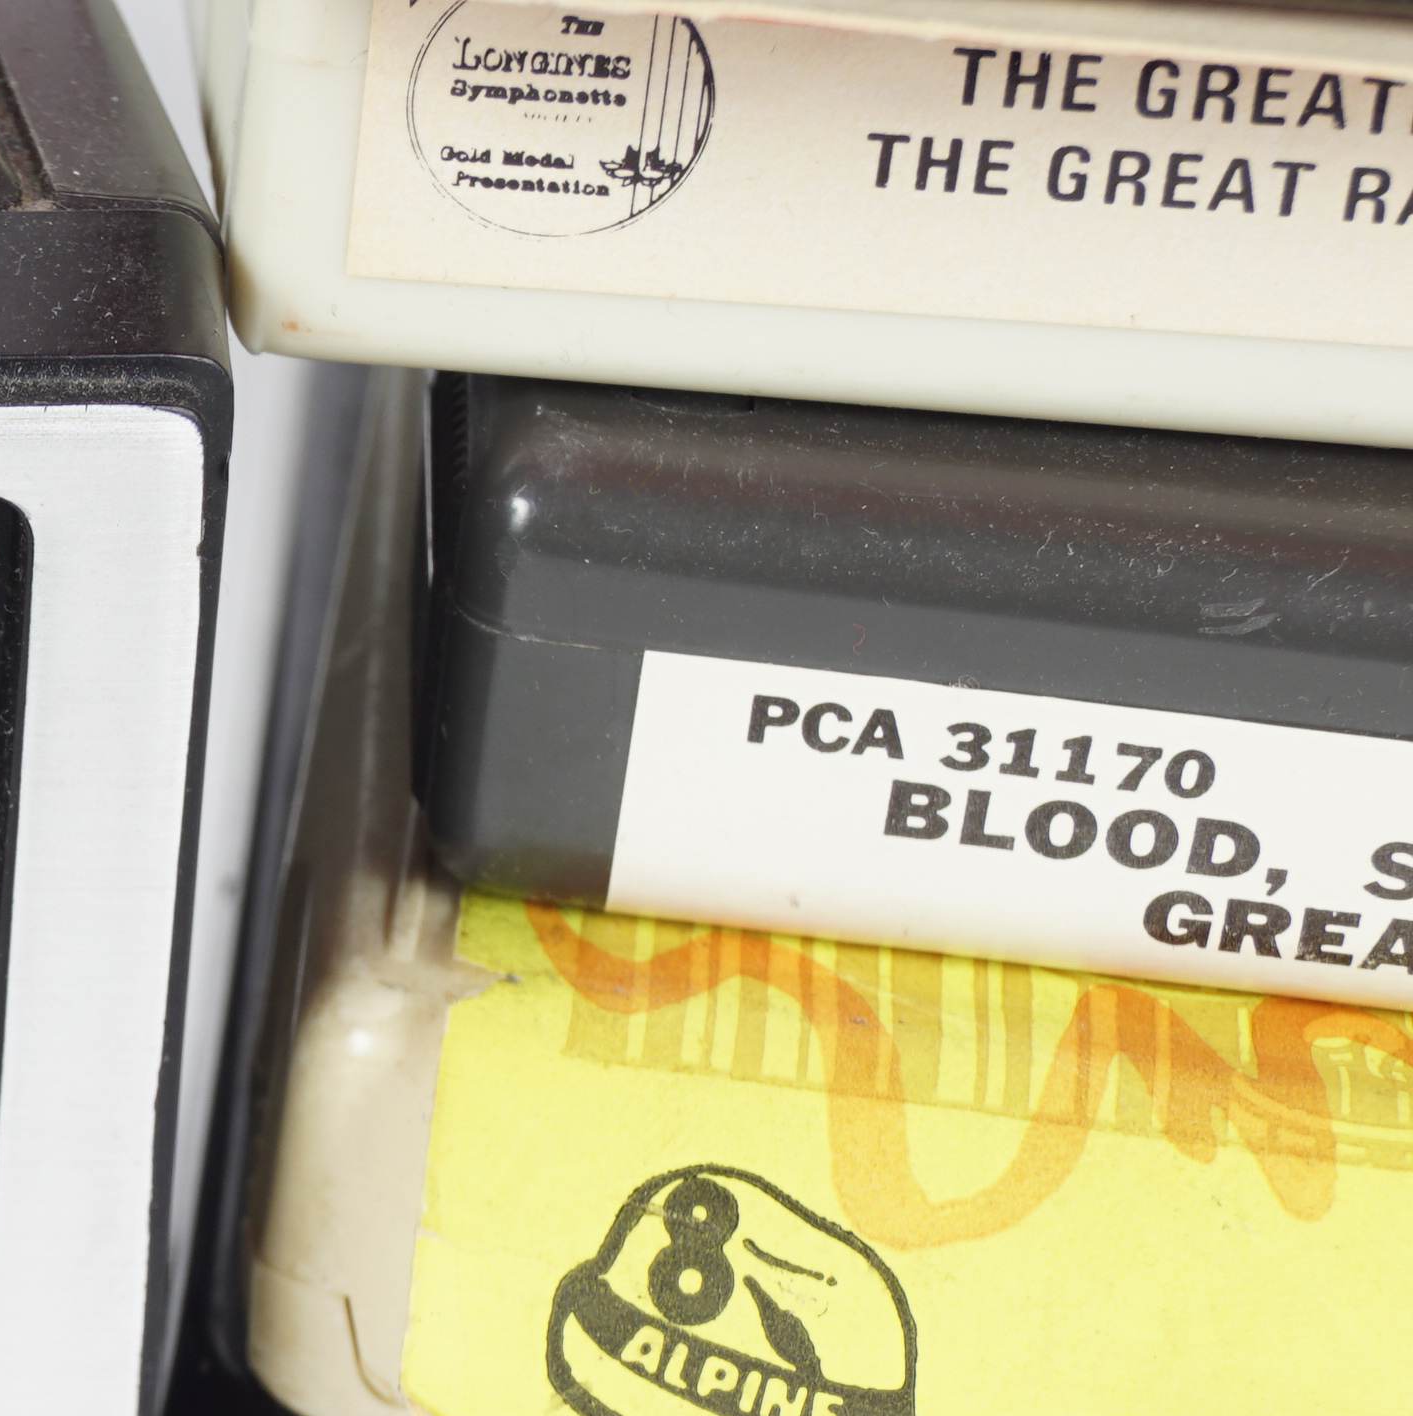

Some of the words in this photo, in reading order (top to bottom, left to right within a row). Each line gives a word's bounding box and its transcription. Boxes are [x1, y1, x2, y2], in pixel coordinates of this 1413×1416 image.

[449, 78, 628, 106] Symphonette
[953, 46, 1103, 112] THE
[1136, 58, 1413, 136] GREAT
[440, 145, 492, 164] Gold
[502, 148, 575, 170] Medal
[451, 170, 611, 197] Presentation
[867, 132, 1015, 196] THE
[1046, 144, 1317, 217] GREAT
[746, 693, 904, 760] PCA
[938, 721, 1217, 799] 31170
[883, 778, 1289, 897] BLOOD,
